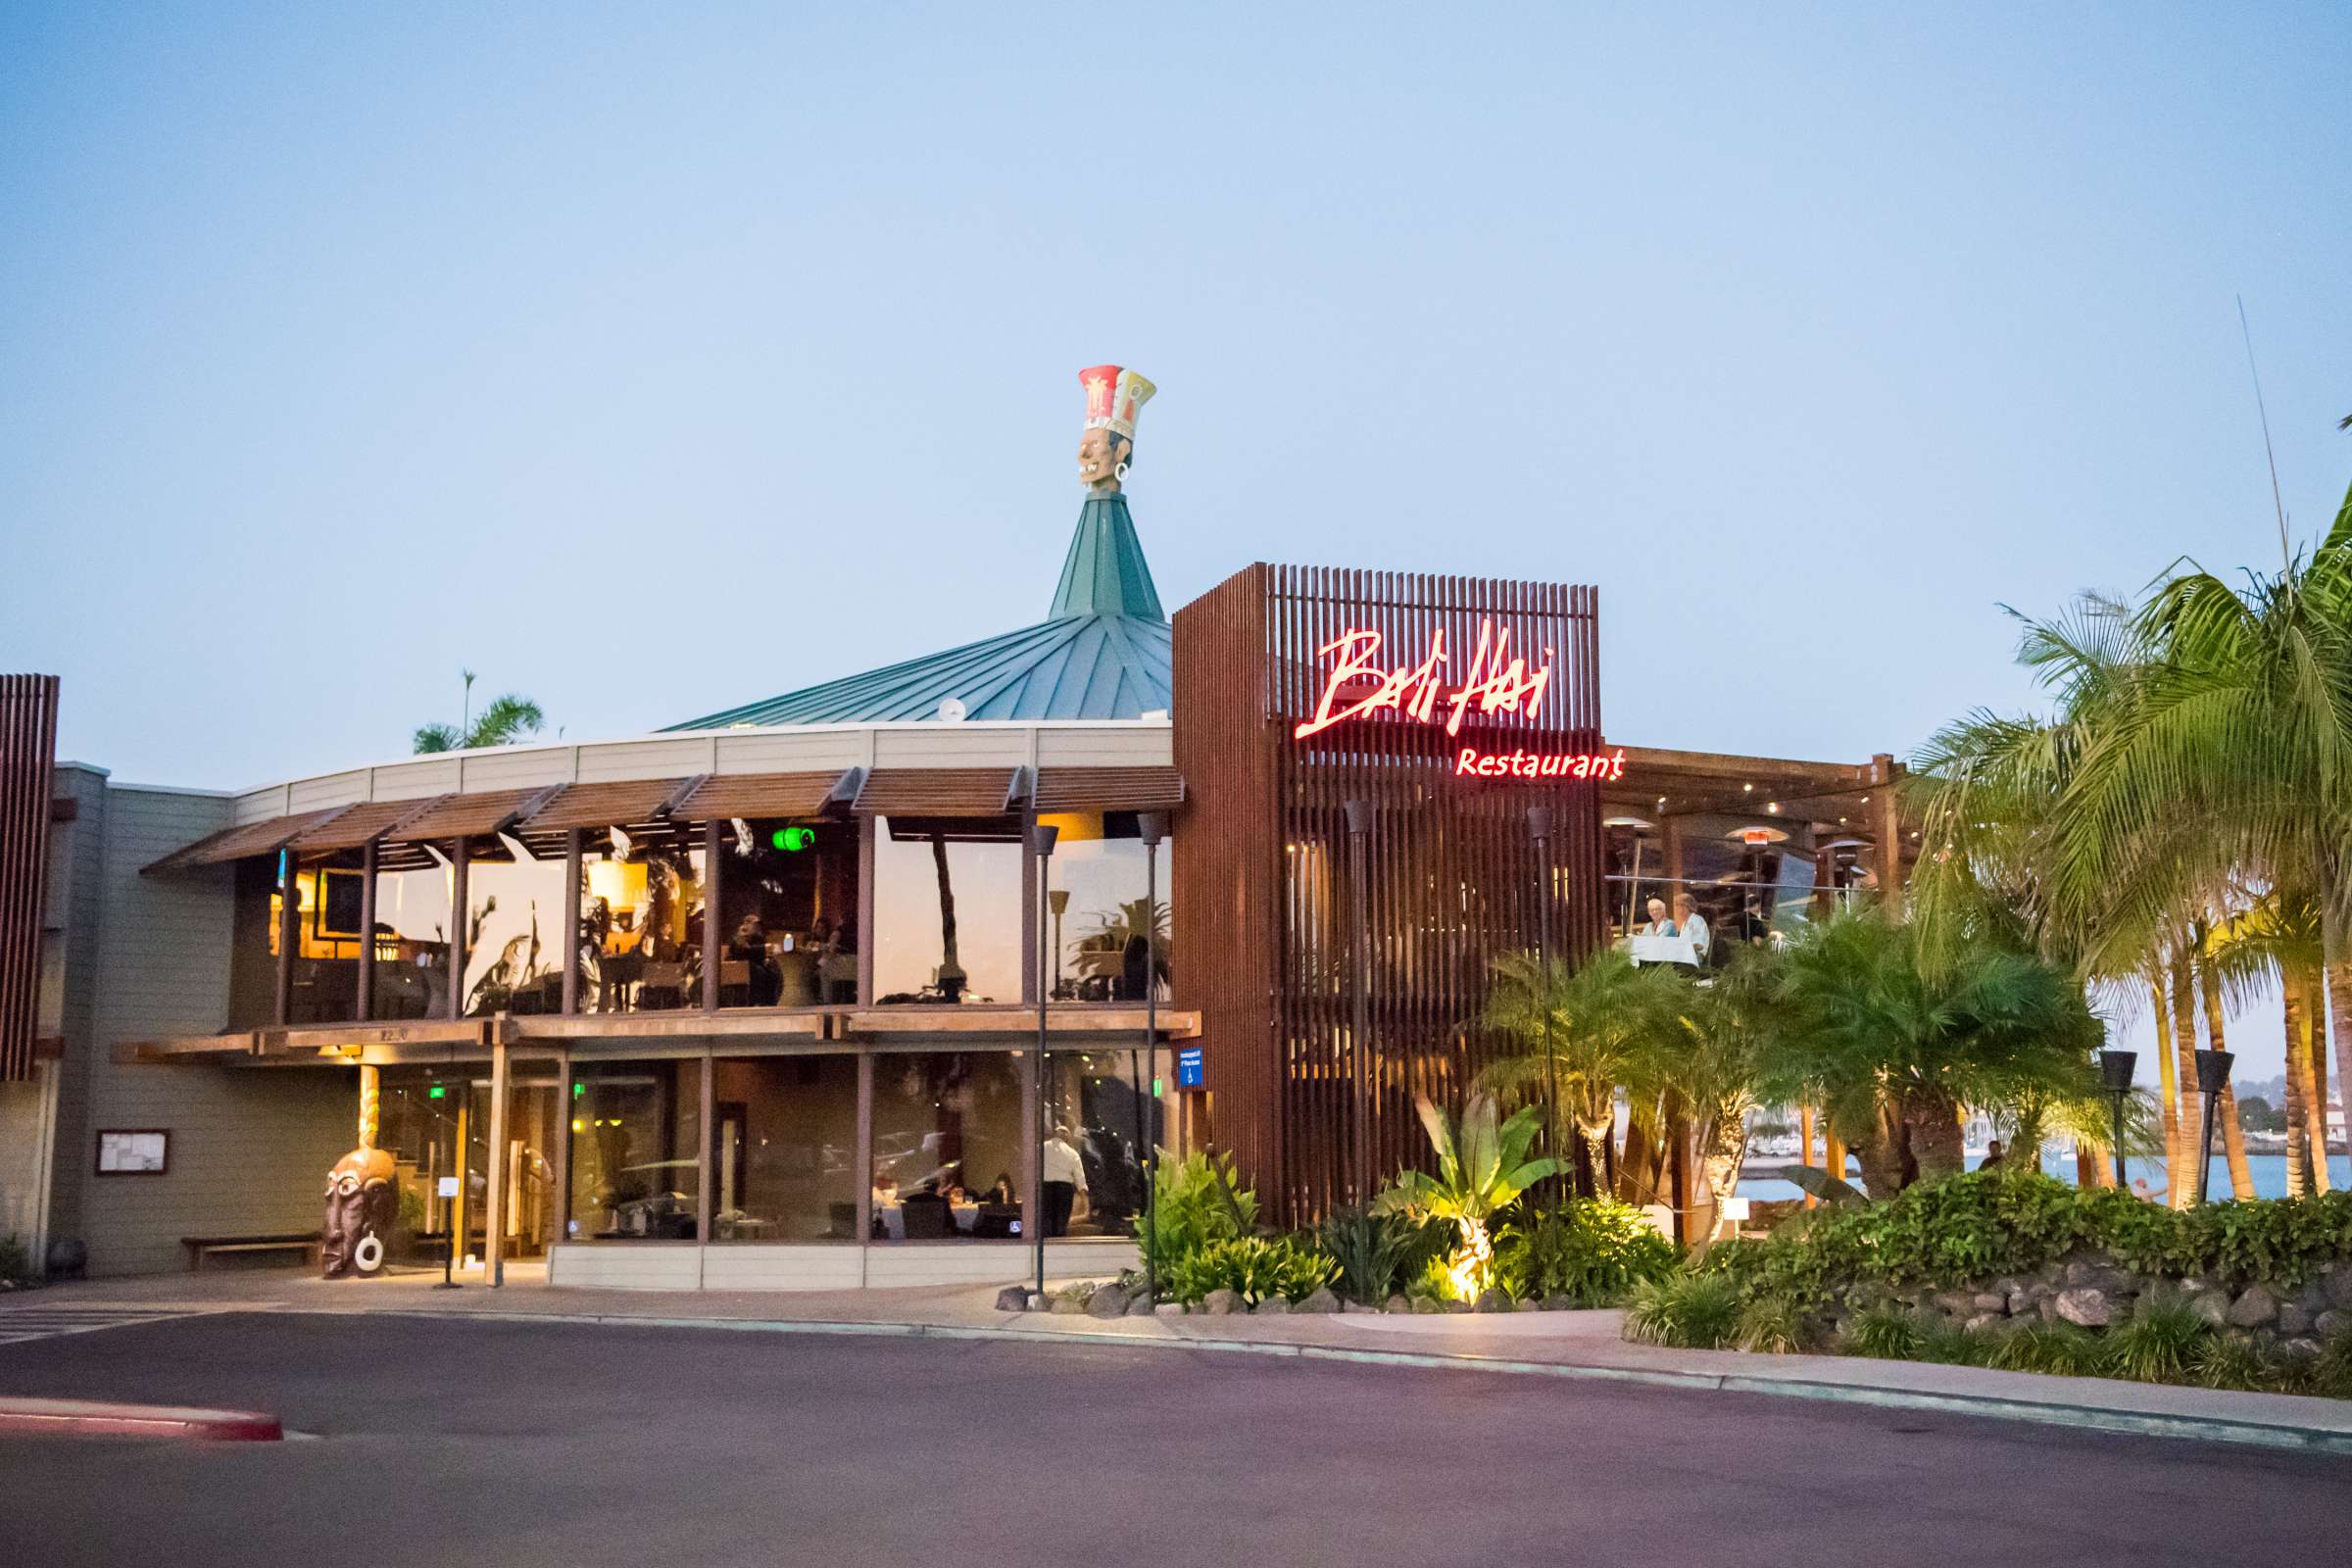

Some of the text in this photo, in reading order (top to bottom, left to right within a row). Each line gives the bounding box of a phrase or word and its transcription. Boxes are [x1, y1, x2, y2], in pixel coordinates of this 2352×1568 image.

[1296, 618, 1554, 739] Bali Hai
[1456, 748, 1626, 781] Restaurant
